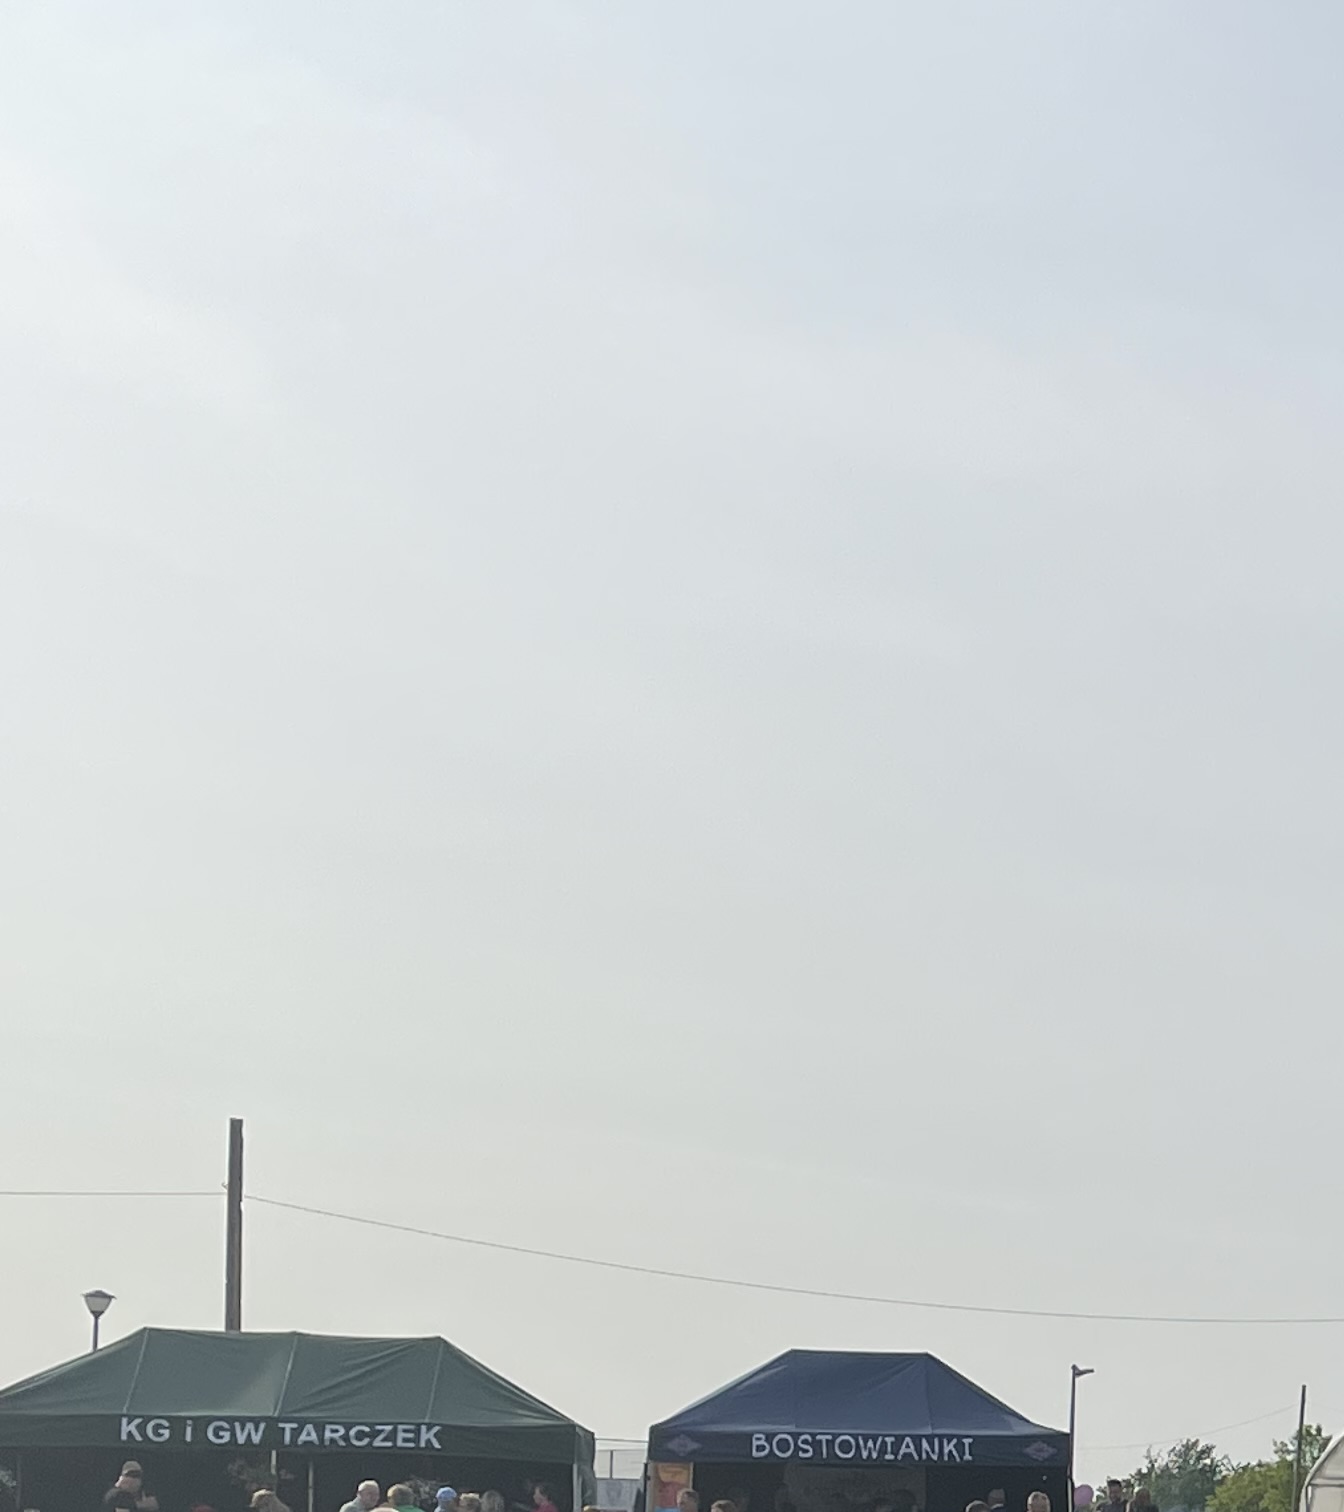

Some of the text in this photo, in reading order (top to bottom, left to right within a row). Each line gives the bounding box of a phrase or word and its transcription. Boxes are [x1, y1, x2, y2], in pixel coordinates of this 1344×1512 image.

[120, 1417, 442, 1449] KG i GW TARCZEK
[751, 1433, 974, 1462] BOSTOWIANKI
